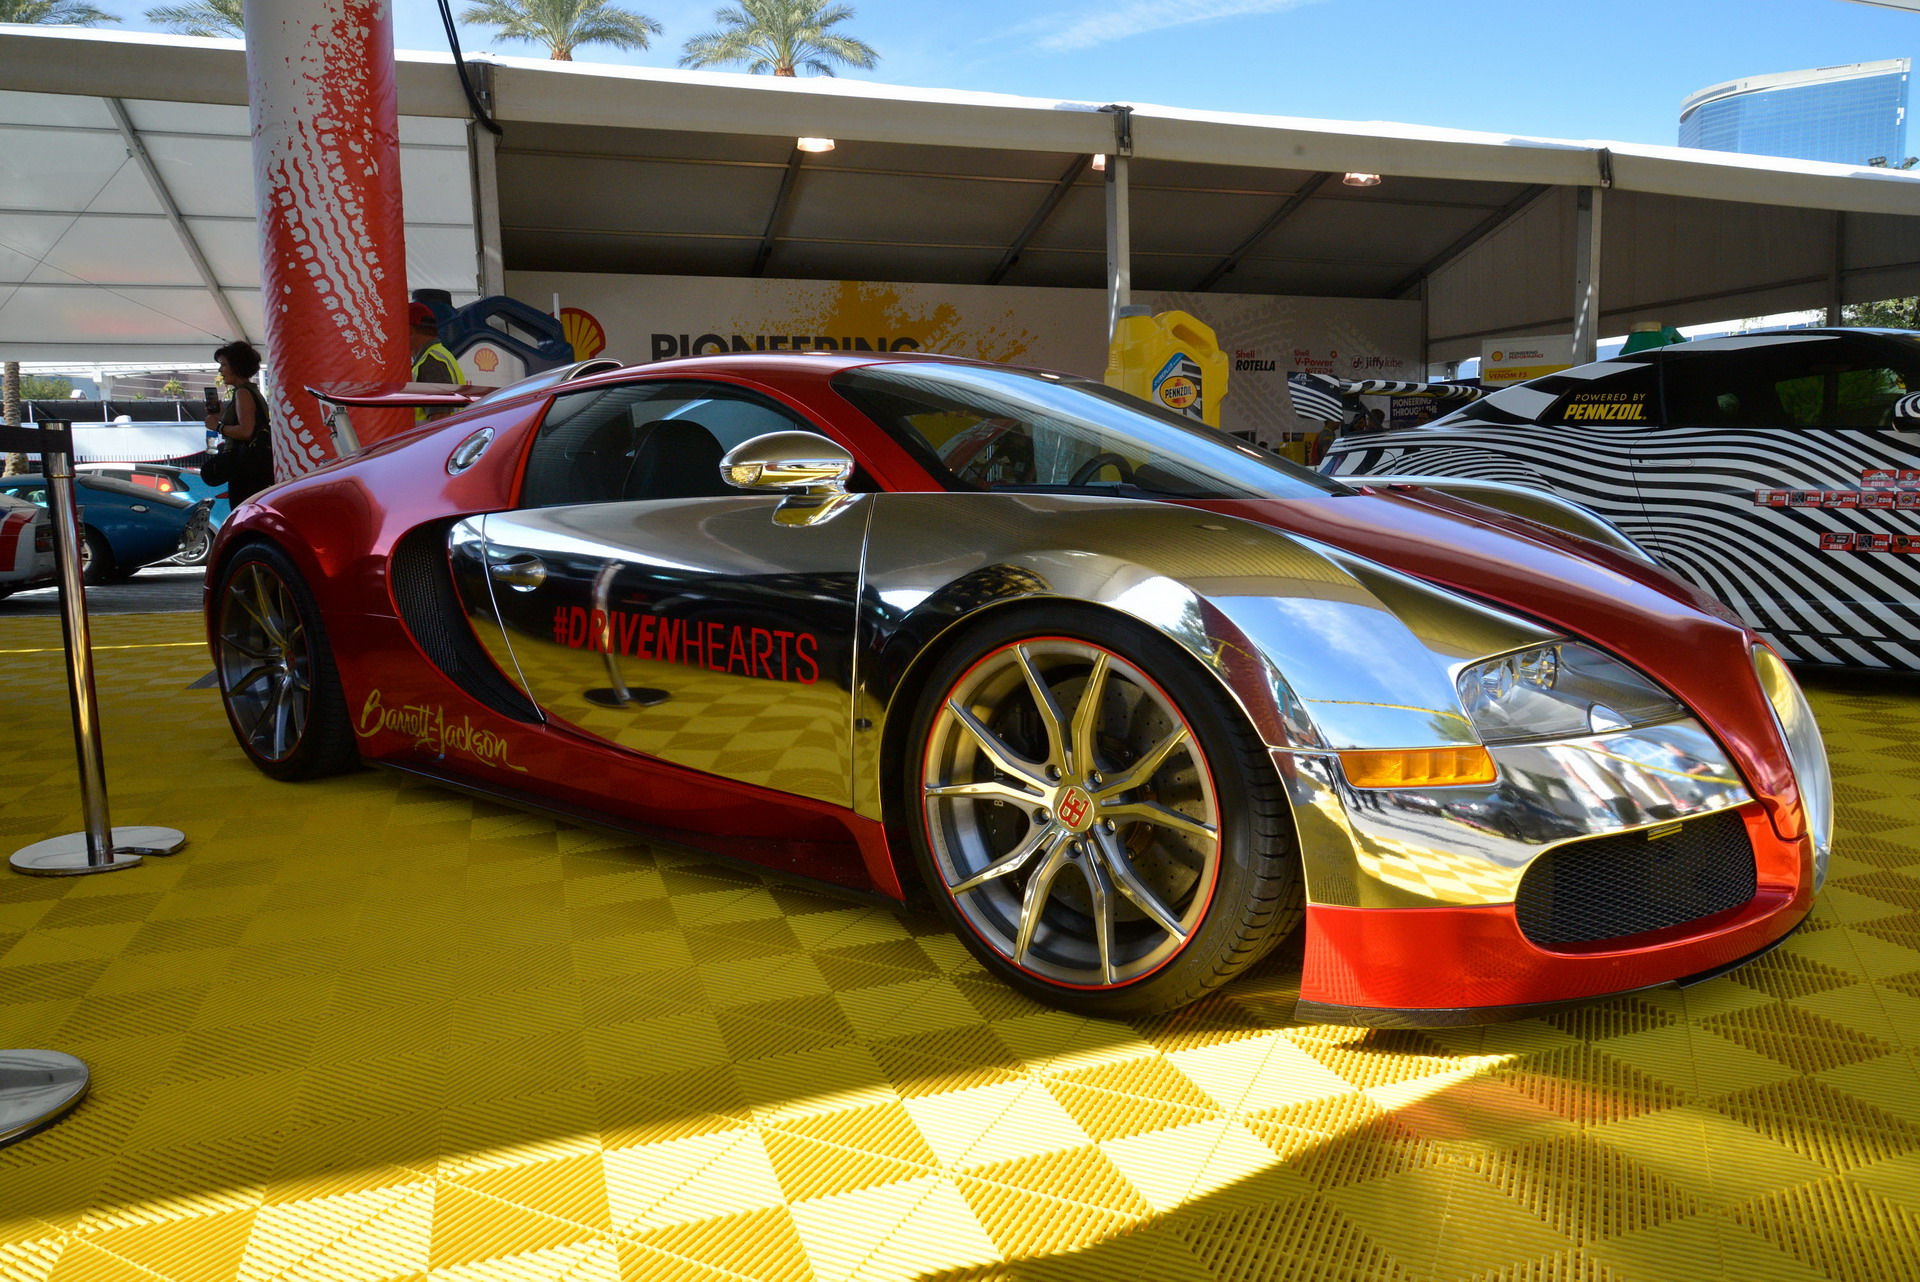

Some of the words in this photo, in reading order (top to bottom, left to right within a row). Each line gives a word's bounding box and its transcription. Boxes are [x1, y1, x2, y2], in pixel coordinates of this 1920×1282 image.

[1235, 349, 1256, 358] Shell
[1235, 359, 1276, 371] ROTELLA
[1164, 385, 1193, 399] PENNZOIL
[1575, 393, 1628, 402] POWERED
[1633, 393, 1646, 401] BY
[1392, 397, 1432, 408] PIONEERING
[553, 606, 819, 685] #DRIVENHEARTS
[353, 688, 528, 772] Barrett-Jackson
